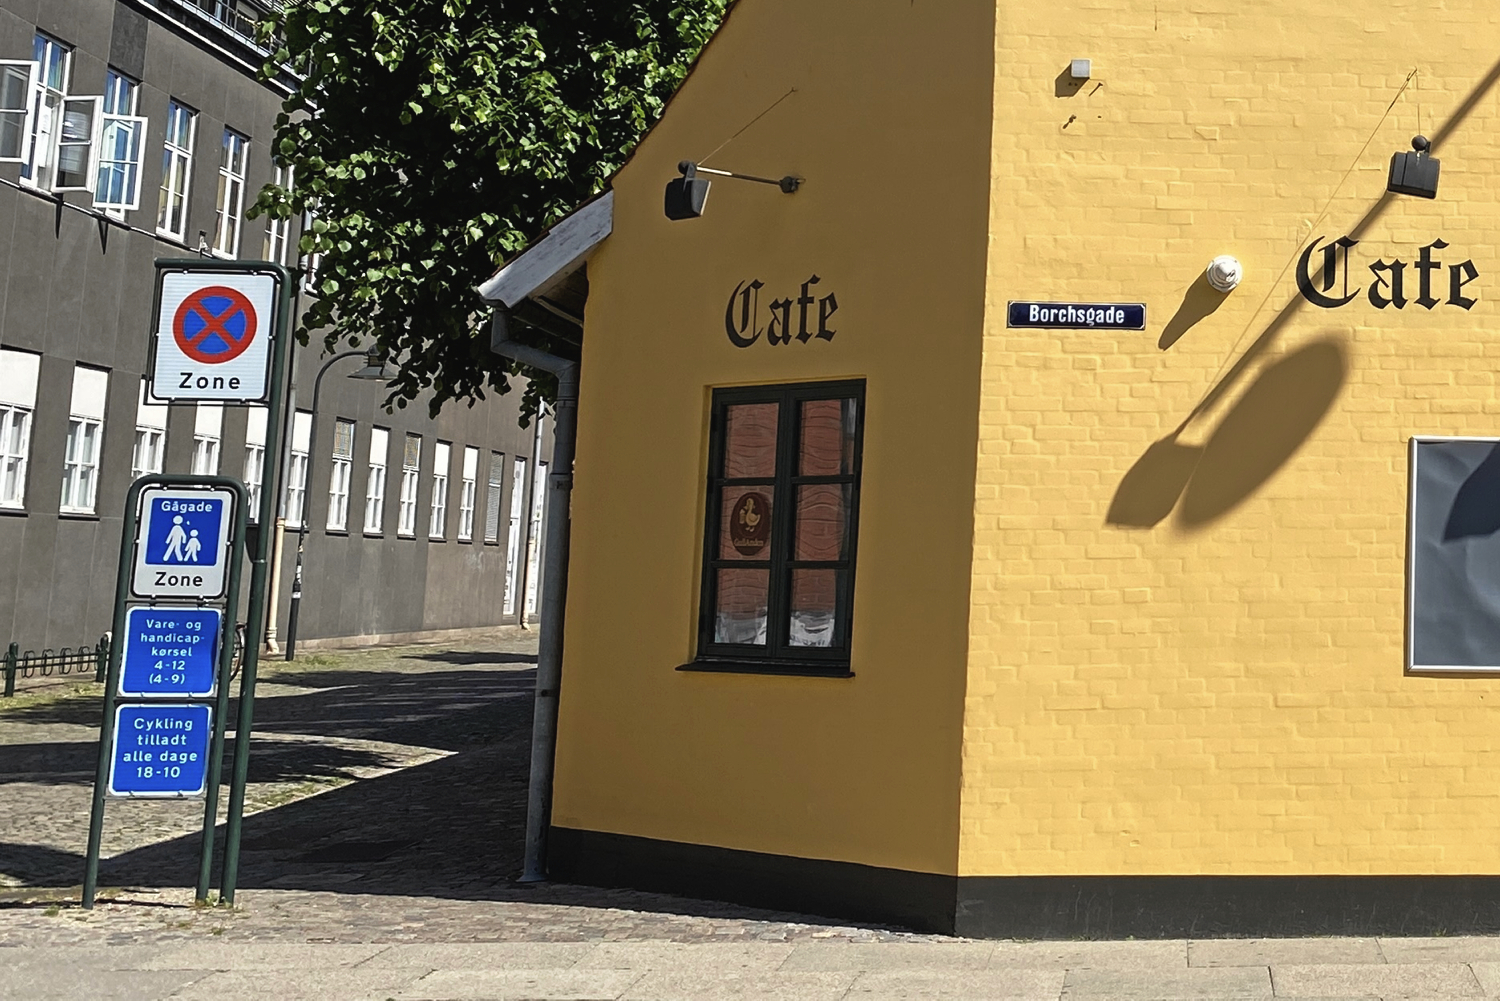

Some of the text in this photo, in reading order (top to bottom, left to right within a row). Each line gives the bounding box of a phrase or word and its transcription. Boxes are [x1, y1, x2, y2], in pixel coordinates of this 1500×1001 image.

[1296, 235, 1479, 311] Cafe
[725, 274, 839, 348] Cafe
[1029, 304, 1125, 326] Borchsgade
[179, 372, 241, 390] Zone
[161, 500, 213, 514] Gågade
[154, 571, 203, 587] Zone
[146, 619, 202, 632] Vare- og
[140, 633, 205, 645] handicap-
[151, 646, 193, 657] kørsel
[133, 718, 194, 731] Cykling
[136, 734, 188, 746] tilladt
[123, 750, 198, 764] alle dage
[136, 766, 181, 779] 18-10
